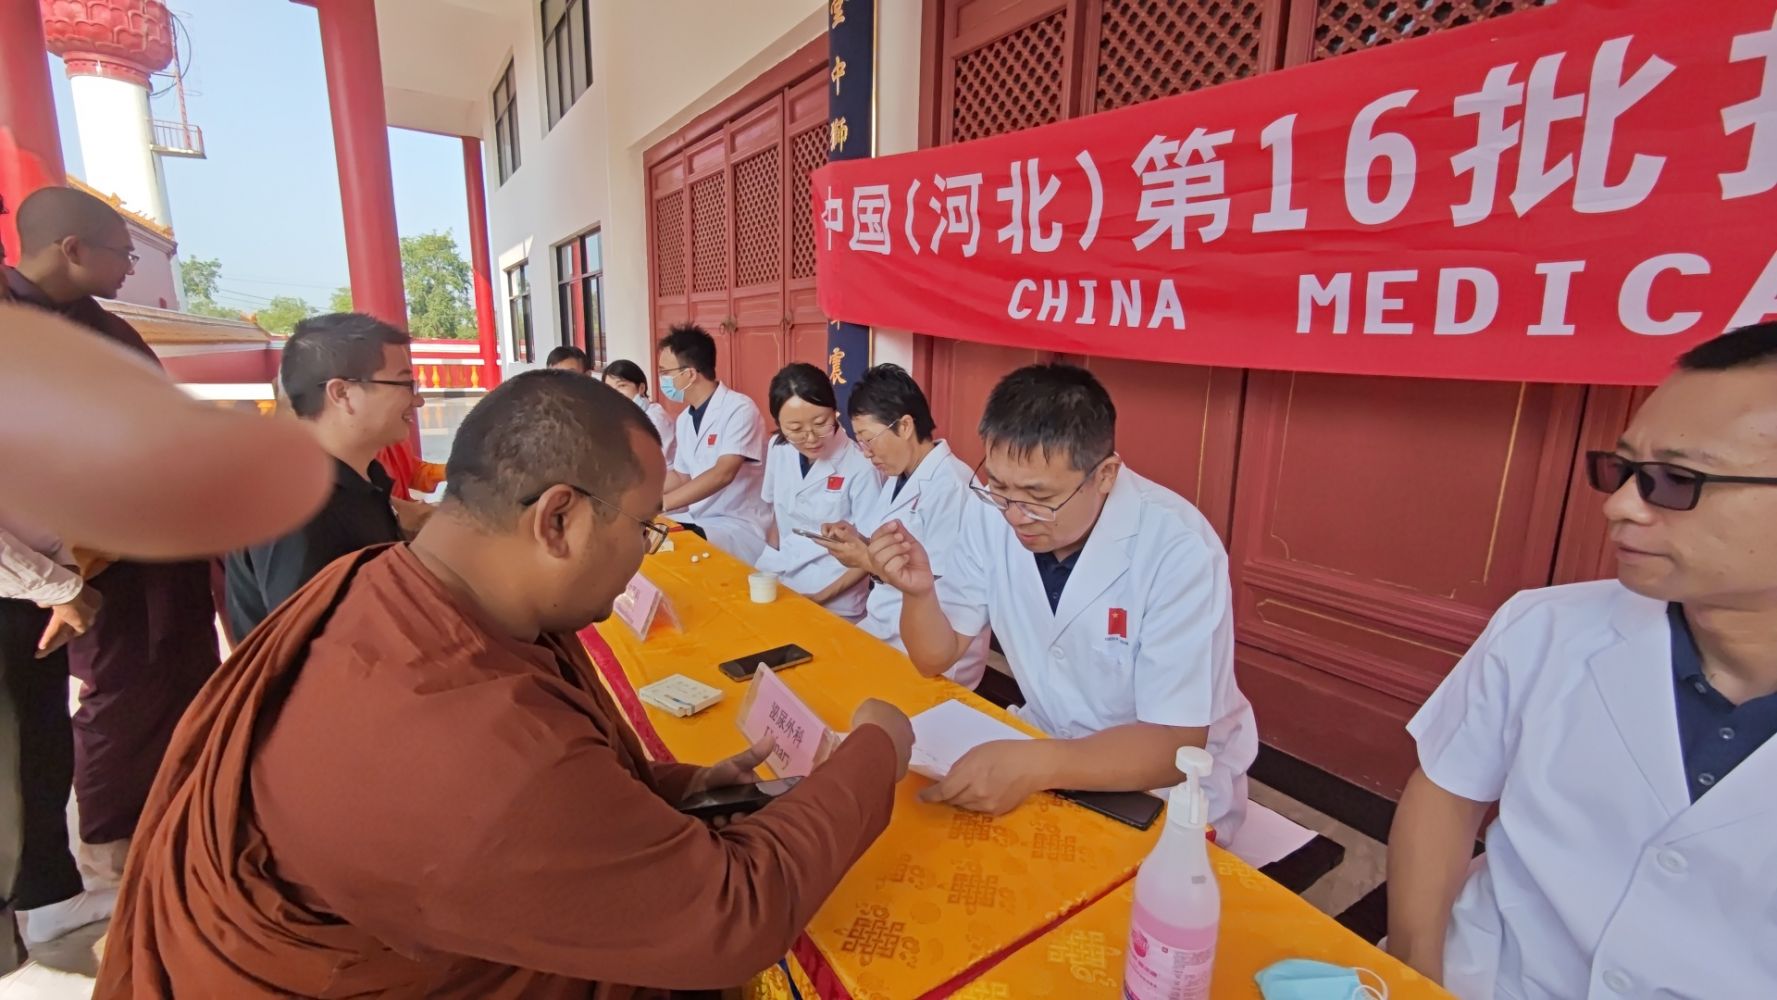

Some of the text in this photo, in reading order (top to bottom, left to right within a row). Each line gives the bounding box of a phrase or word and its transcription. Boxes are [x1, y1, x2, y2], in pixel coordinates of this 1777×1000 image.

[1007, 278, 1187, 330] CHINA
[763, 725, 790, 770] Unary
[769, 701, 805, 749] 泌尿外科
